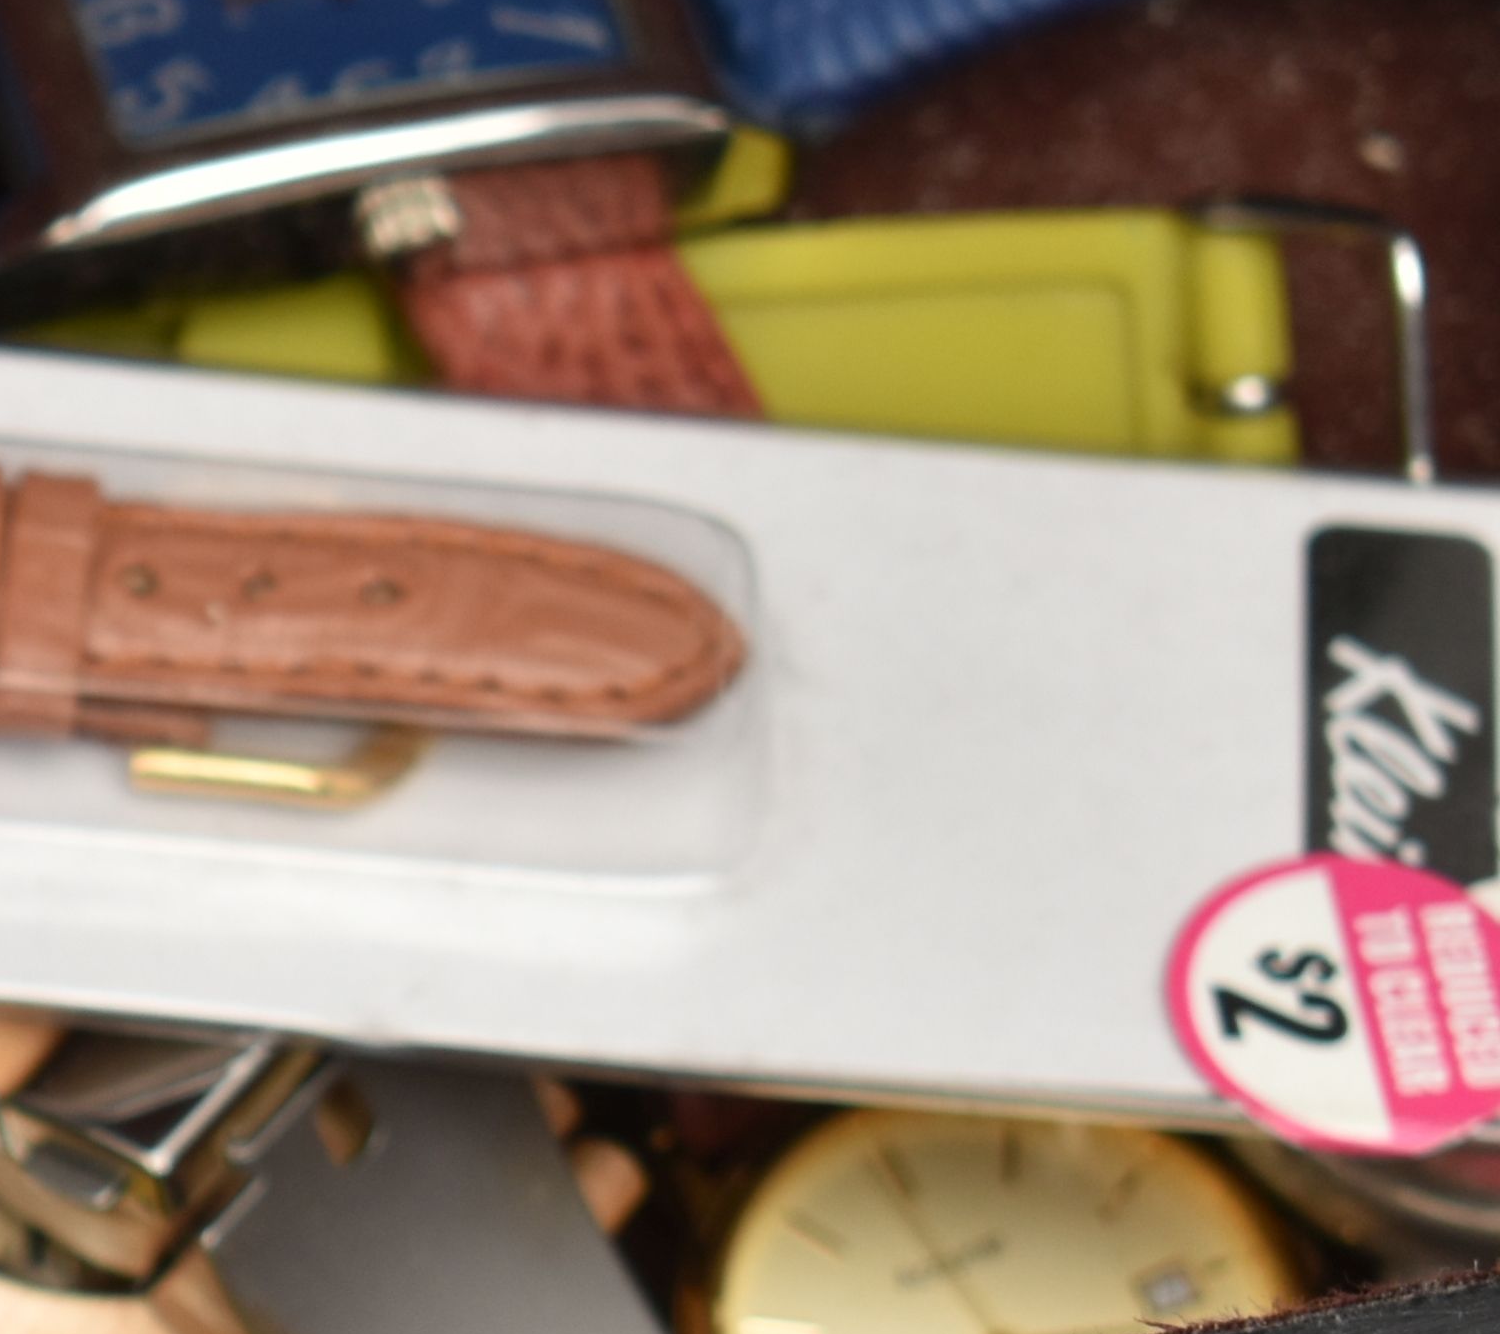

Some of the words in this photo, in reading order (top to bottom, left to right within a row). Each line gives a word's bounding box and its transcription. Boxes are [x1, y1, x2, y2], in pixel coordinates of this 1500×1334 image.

[1328, 632, 1481, 865] Klei
[1353, 904, 1416, 962] TO
[1209, 946, 1349, 1046] $2
[1369, 965, 1451, 1097] CLEAR
